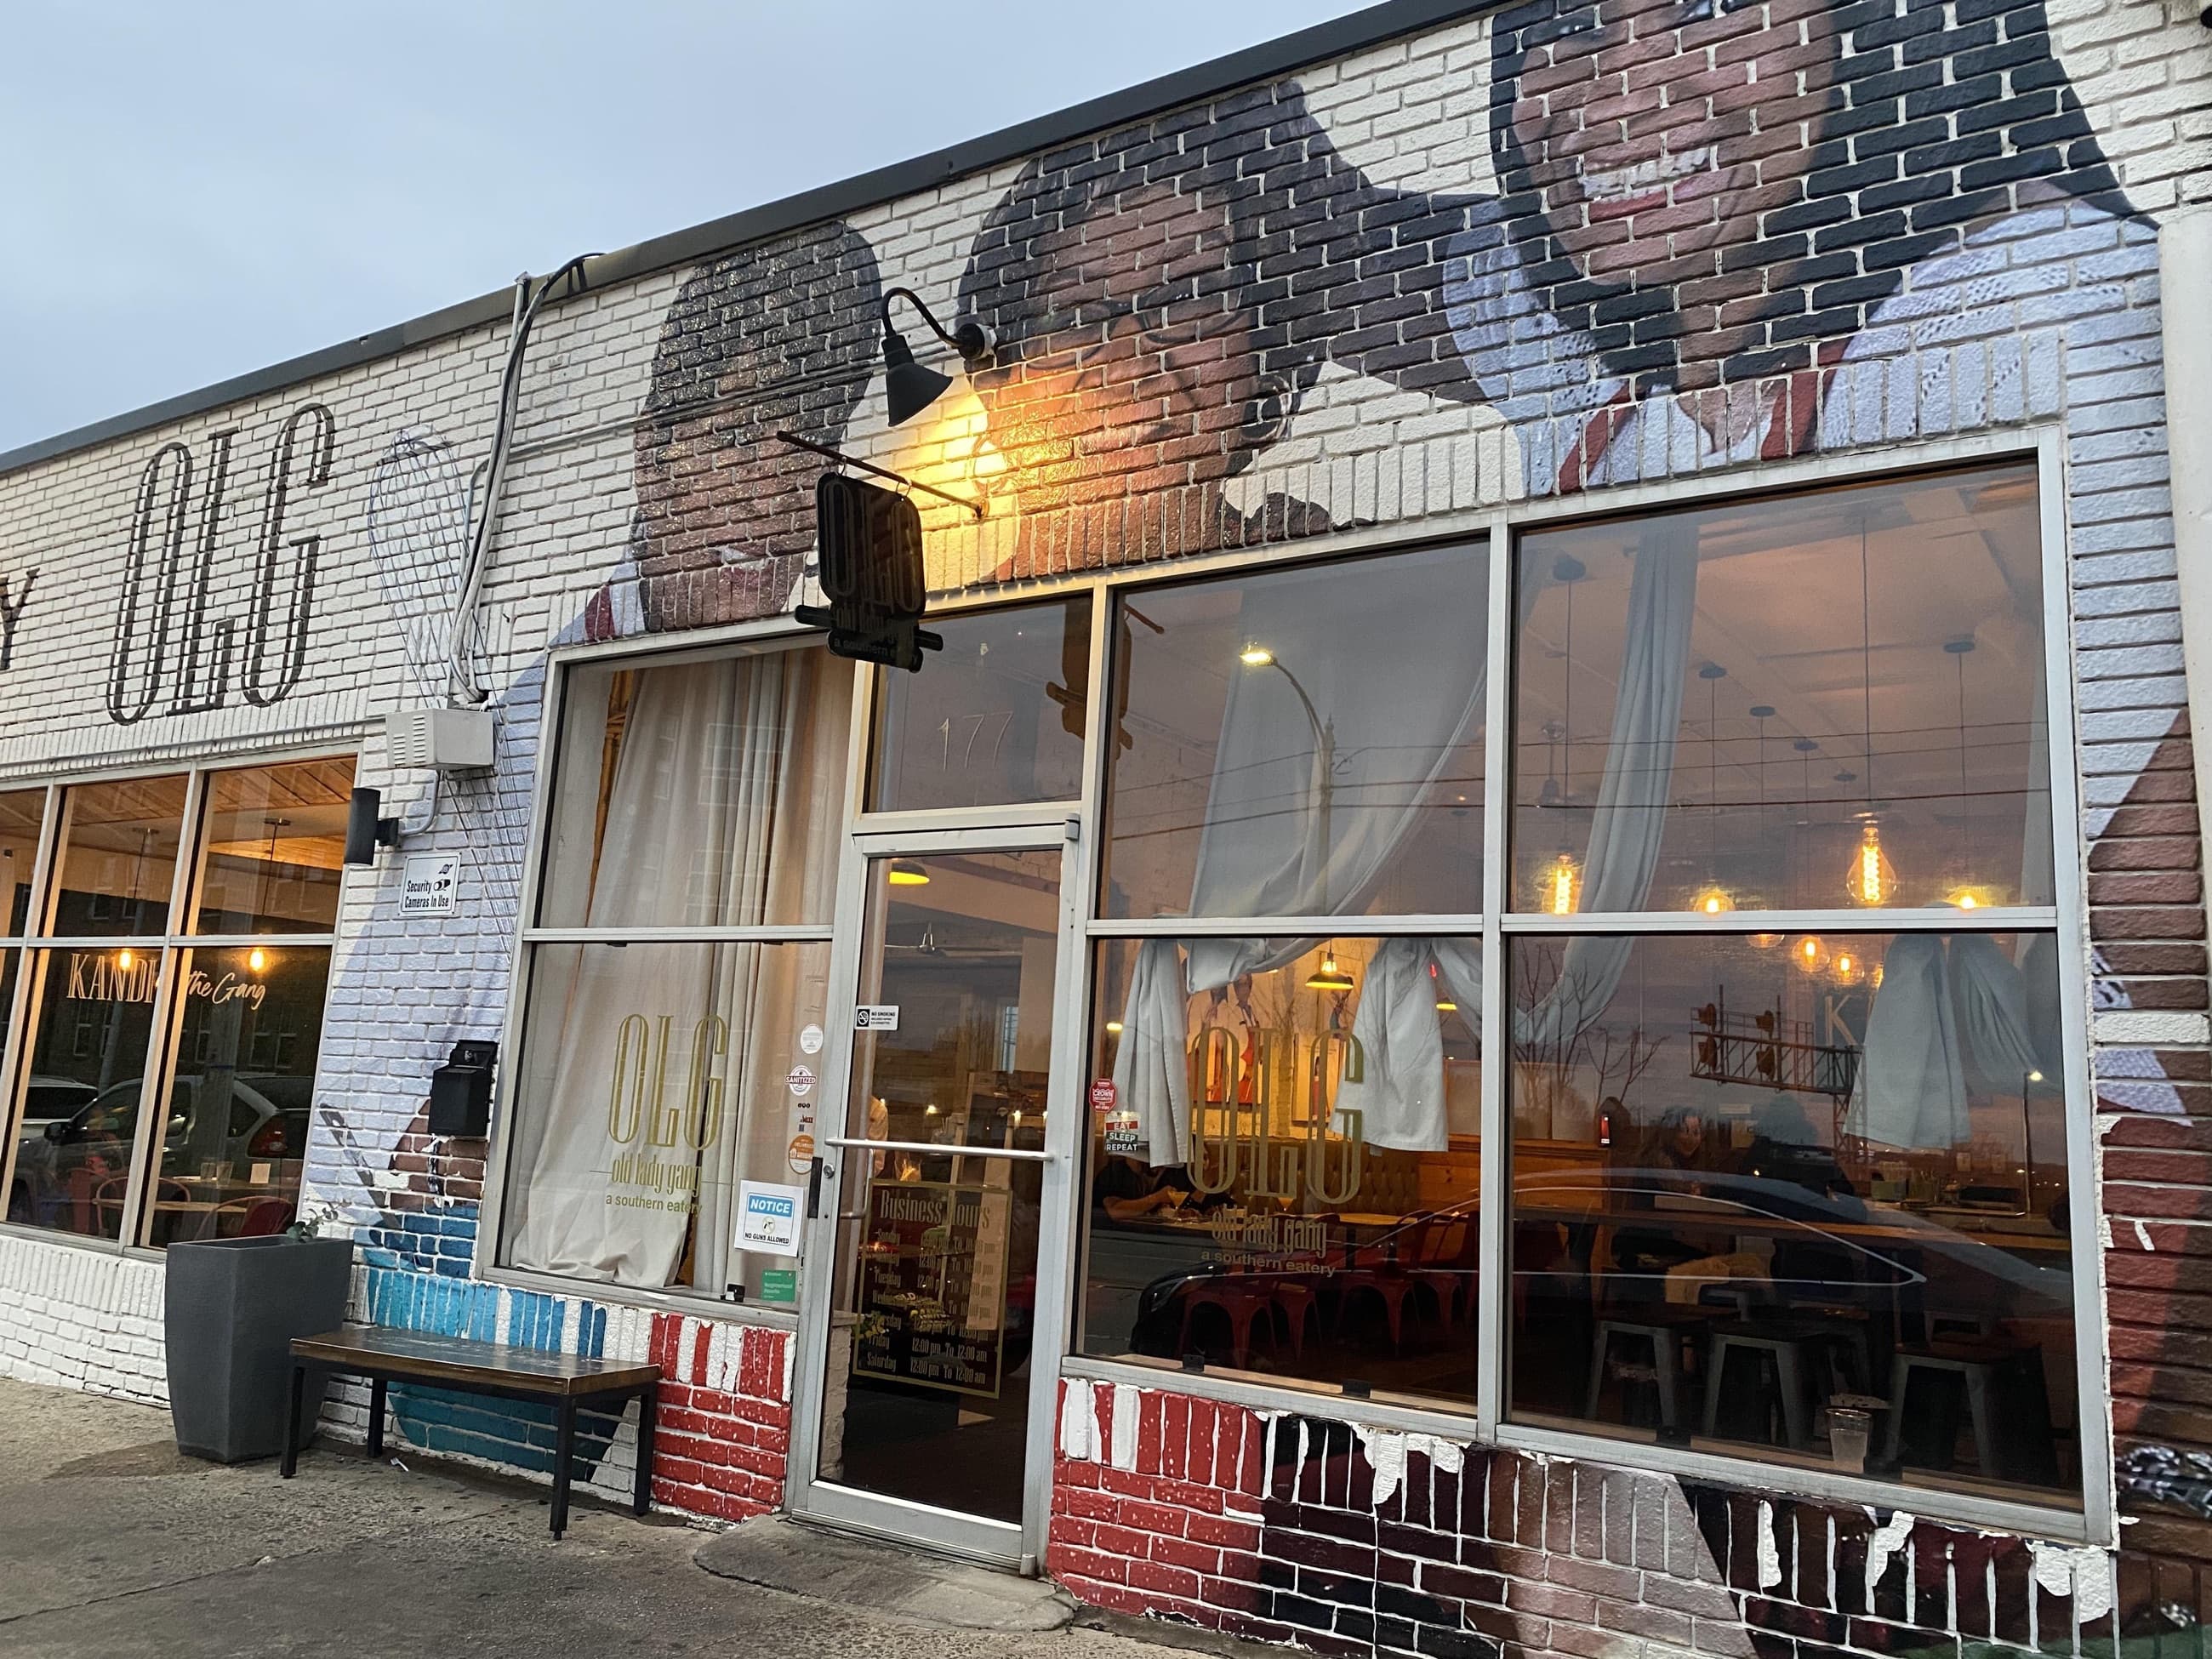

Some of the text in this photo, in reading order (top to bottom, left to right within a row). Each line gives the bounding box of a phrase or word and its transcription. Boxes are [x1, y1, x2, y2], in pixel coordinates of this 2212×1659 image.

[105, 402, 336, 726] OLG
[938, 710, 1014, 770] 177
[407, 879, 432, 894] Security
[404, 894, 449, 908] Cameras In Use
[212, 972, 266, 1011] Gang
[608, 1013, 727, 1151] OLG
[785, 1076, 816, 1085] SANITIZED
[1114, 1122, 1131, 1131] EAT
[1187, 1025, 1364, 1205] OLG
[1106, 1143, 1137, 1152] REPEAT
[1109, 1132, 1136, 1142] SLEEP
[612, 1151, 702, 1197] old lady gang
[605, 1194, 613, 1205] a
[614, 1193, 664, 1211] southern
[750, 1198, 791, 1214] NOTICE
[880, 1189, 944, 1224] Business
[753, 1233, 767, 1241] GUNS
[767, 1234, 790, 1245] ALLOWED
[1211, 1202, 1328, 1259] old lady gang
[1200, 1251, 1337, 1278] a southern eatery
[912, 1337, 929, 1354] 12:00
[930, 1342, 941, 1357] pm
[944, 1343, 955, 1357] To
[957, 1343, 976, 1361] 12:00
